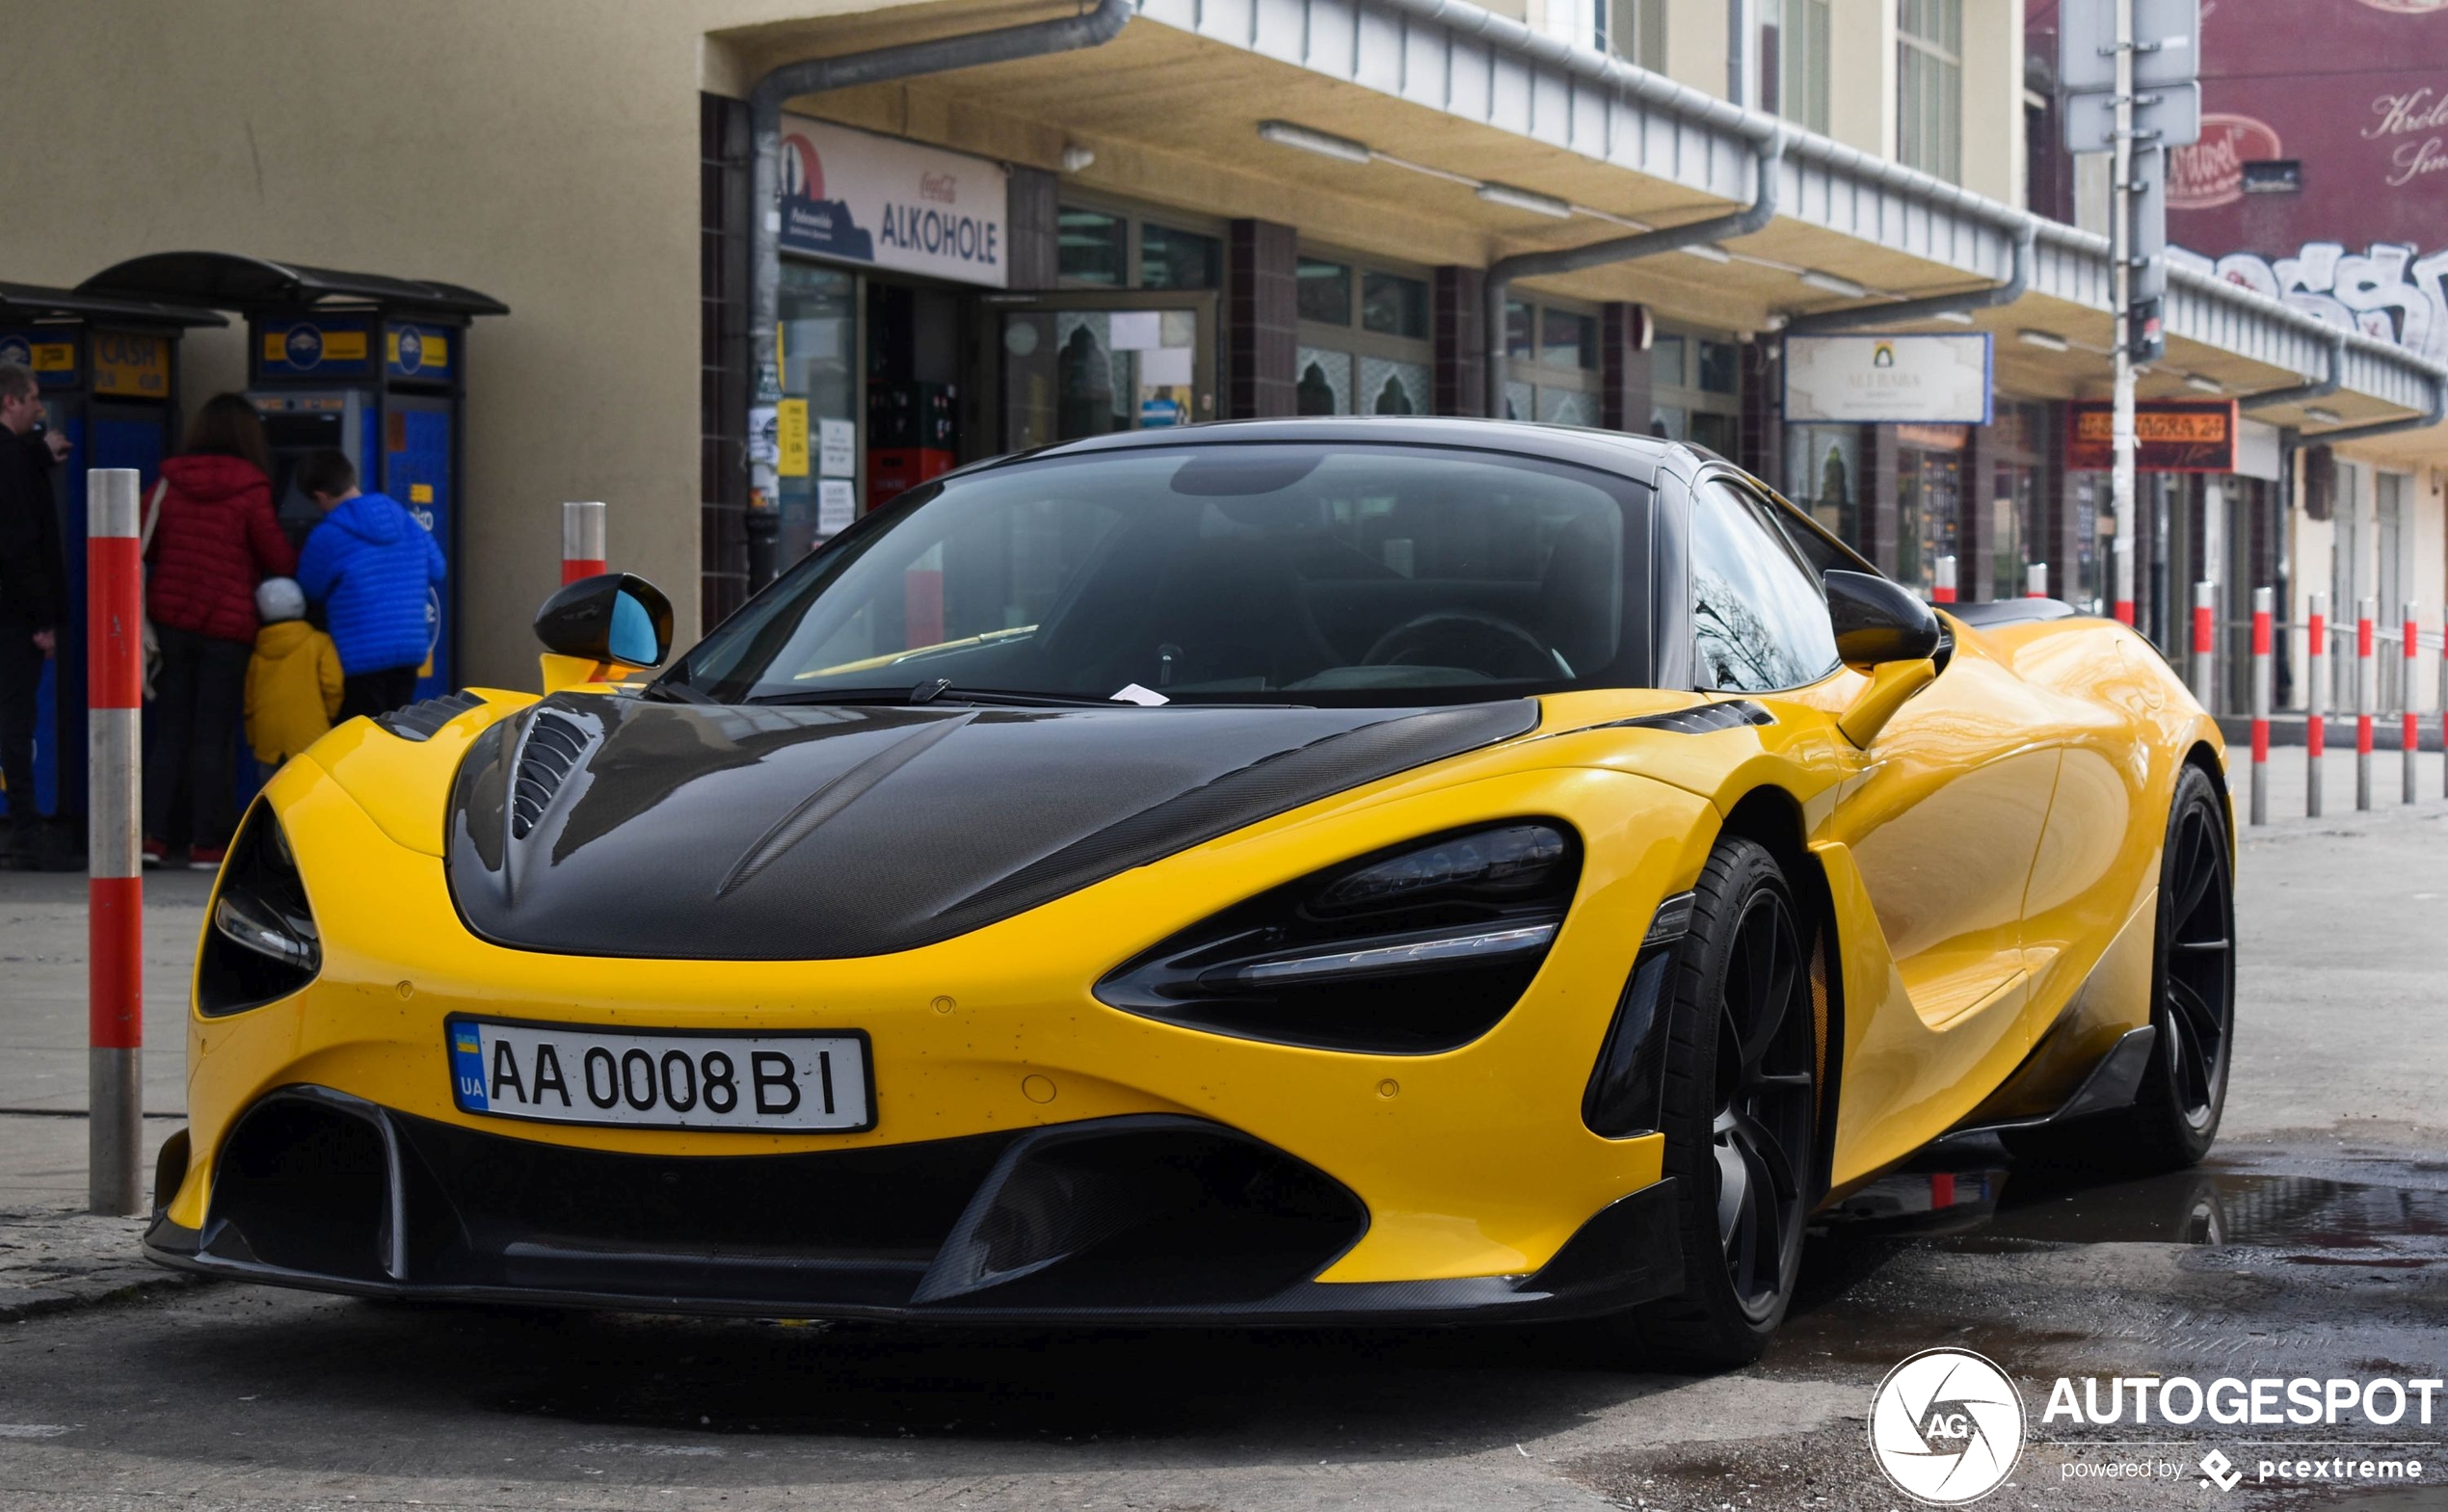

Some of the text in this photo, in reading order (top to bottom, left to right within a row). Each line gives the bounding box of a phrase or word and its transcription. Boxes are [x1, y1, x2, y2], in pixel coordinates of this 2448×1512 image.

[881, 200, 997, 265] ALKOHOLE
[101, 334, 156, 366] CASH
[461, 1076, 484, 1097] UA
[492, 1040, 835, 1114] AA 0008 BI
